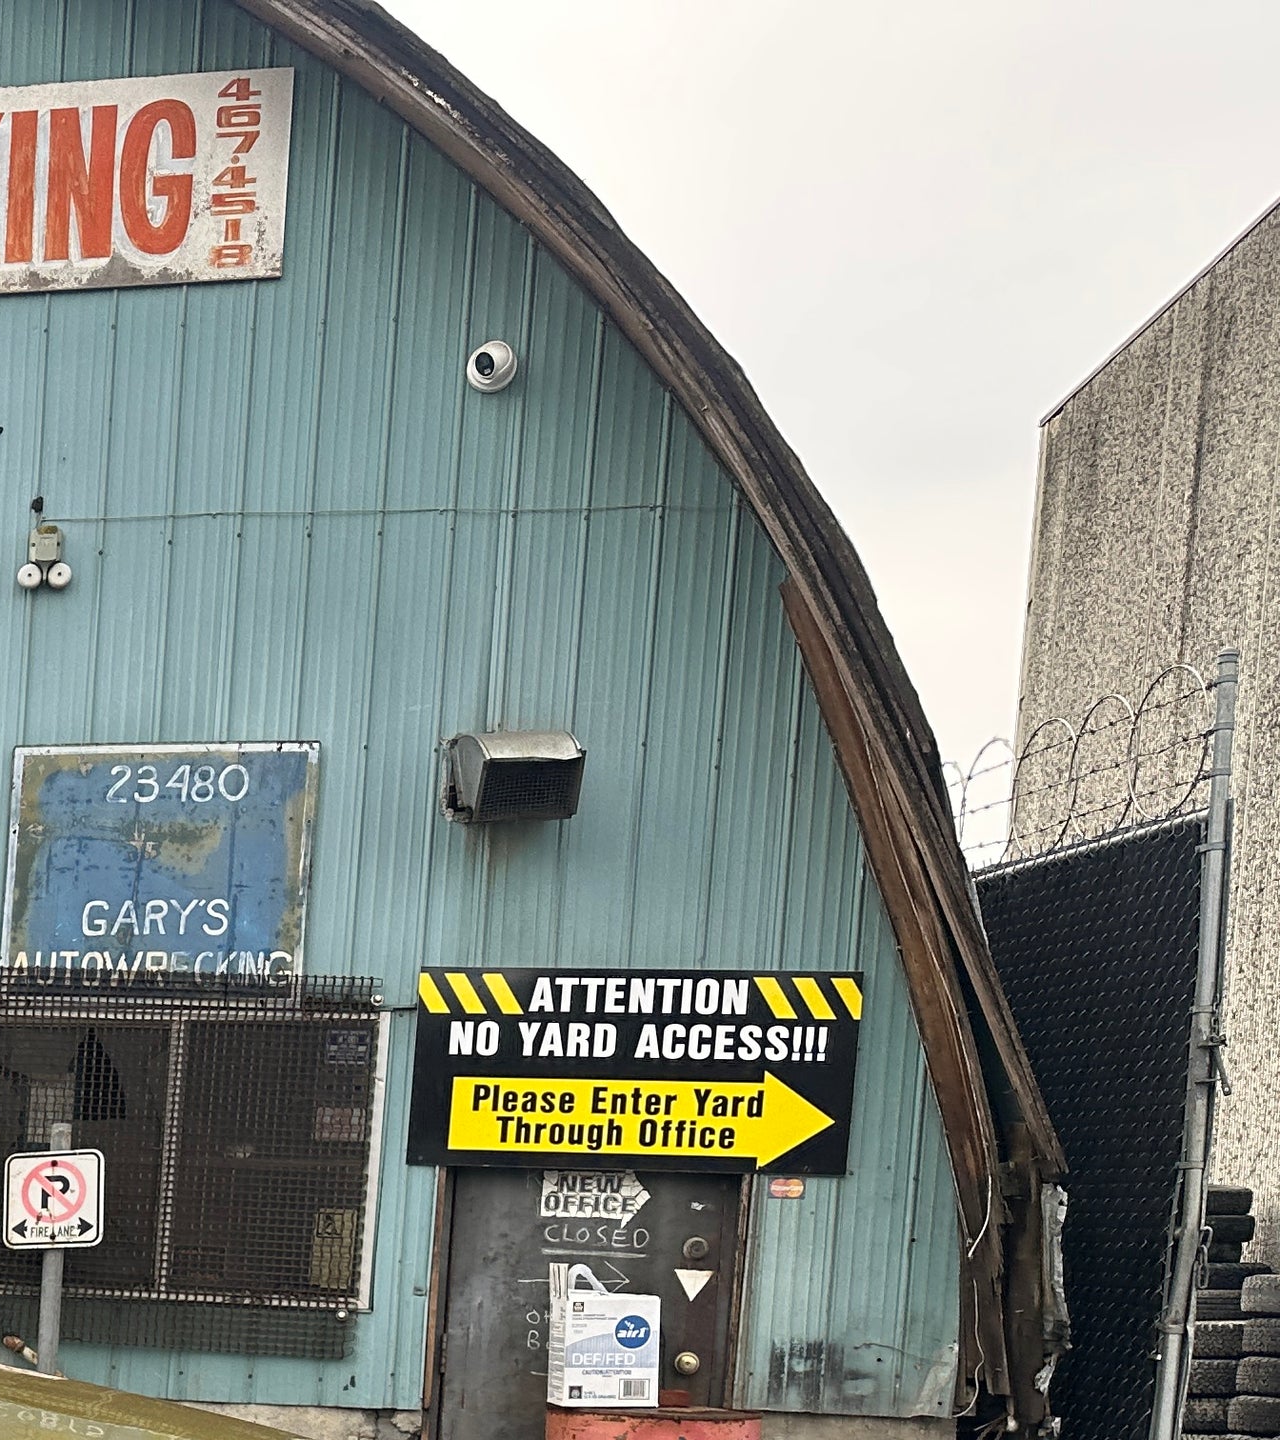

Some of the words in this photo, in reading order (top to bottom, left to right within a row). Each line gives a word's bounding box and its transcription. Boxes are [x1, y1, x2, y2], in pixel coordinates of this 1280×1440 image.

[106, 764, 250, 803] 23480
[81, 899, 230, 937] GARY'S
[528, 977, 749, 1015] ATTENTION
[448, 1021, 500, 1057] NO
[519, 1022, 617, 1058] YARD
[634, 1026, 829, 1062] ACCESS!!!
[472, 1084, 575, 1114] Please
[591, 1086, 677, 1116] Enter
[694, 1088, 765, 1118] Yard
[496, 1116, 623, 1151] Through
[639, 1119, 736, 1149] Office
[558, 1174, 621, 1193] NEW
[544, 1191, 636, 1213] OFFICE
[30, 1226, 49, 1238] FIRE
[544, 1224, 650, 1248] CLOSED
[572, 1352, 636, 1366] DEF/FED
